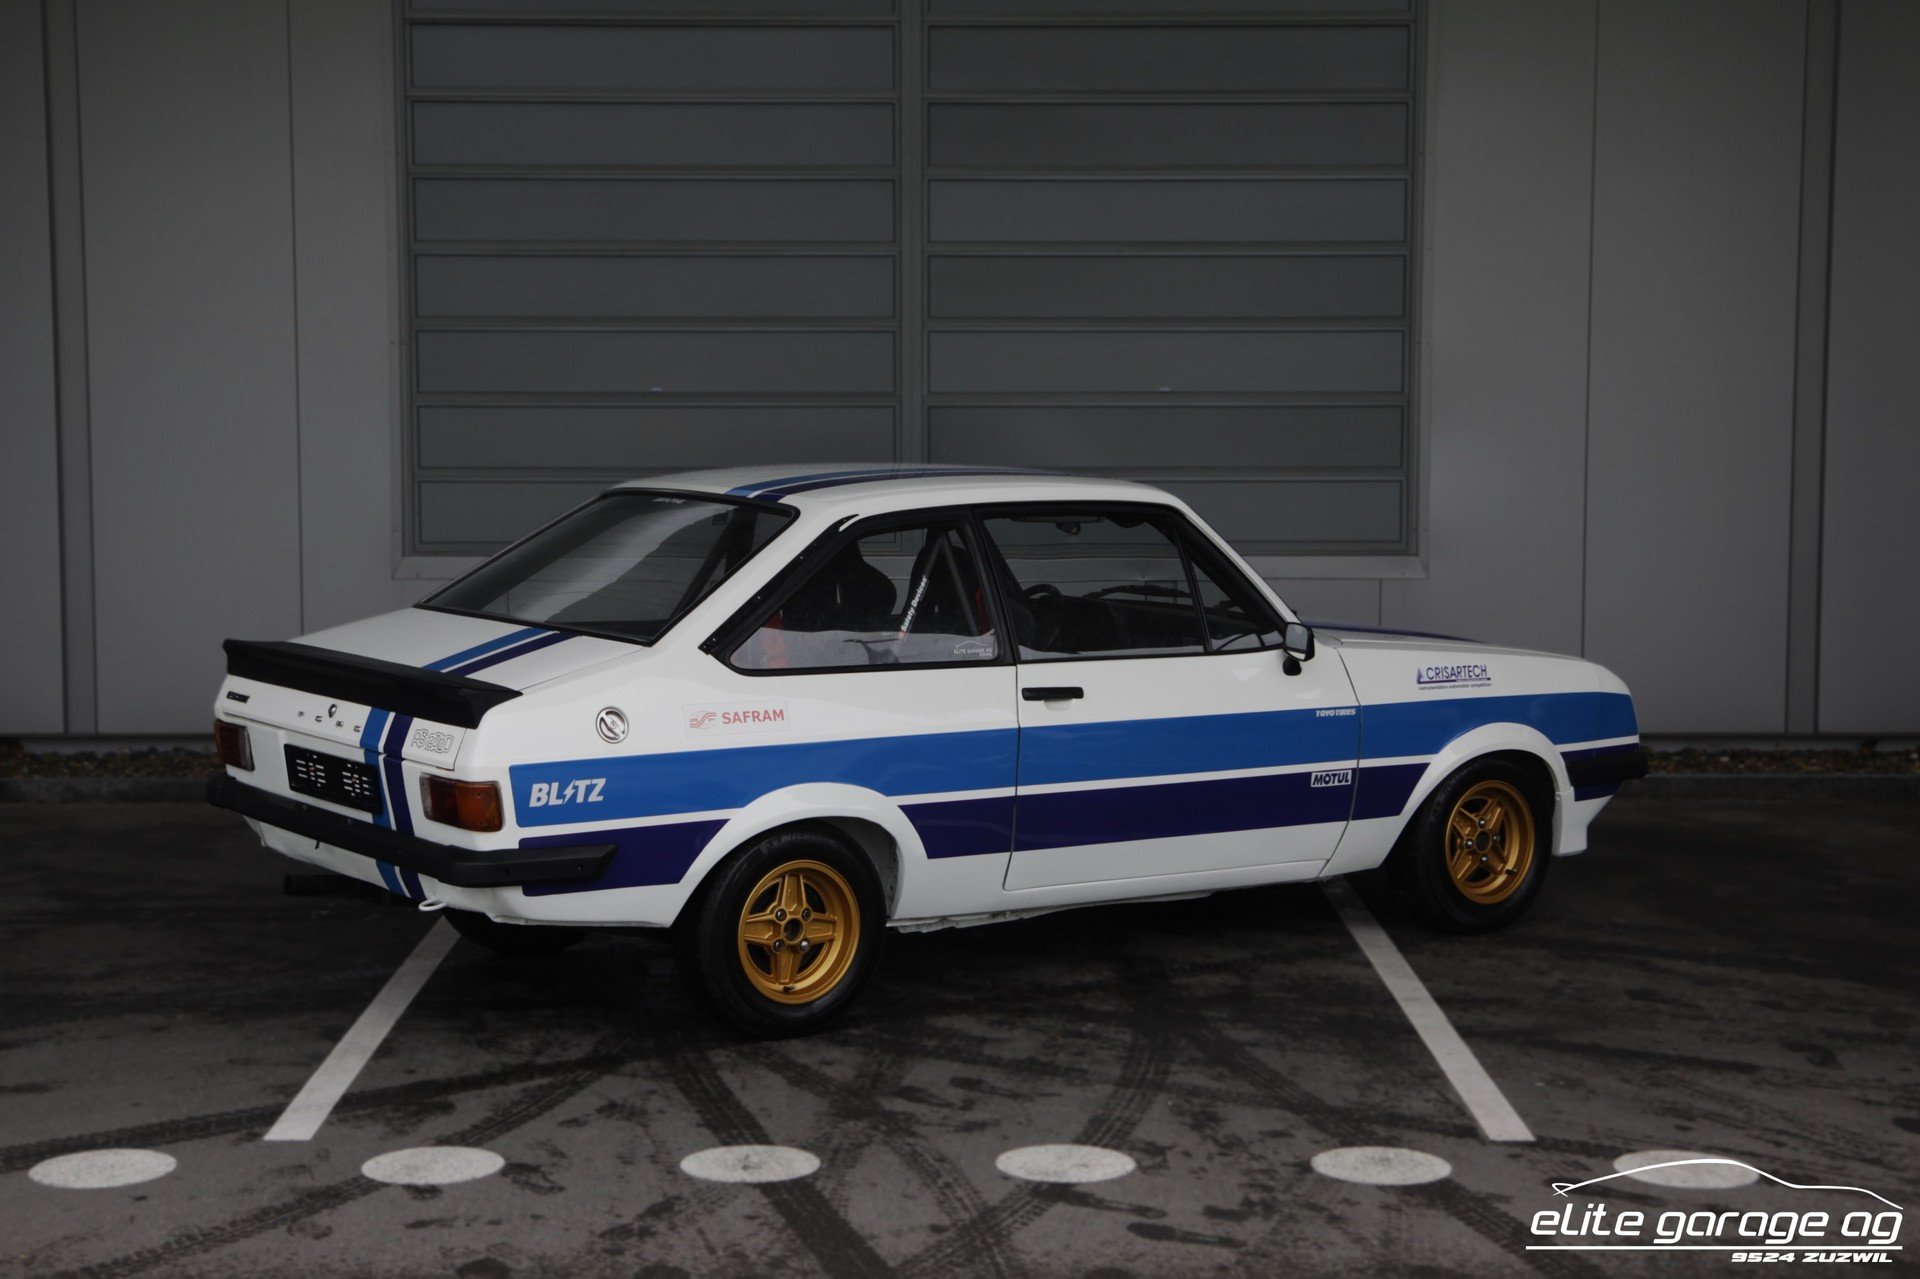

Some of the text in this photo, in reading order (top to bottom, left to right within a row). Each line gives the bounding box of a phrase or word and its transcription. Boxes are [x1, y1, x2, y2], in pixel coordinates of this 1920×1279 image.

[1426, 664, 1488, 680] CRISARTECH
[721, 709, 785, 724] SAFRAM
[1316, 708, 1356, 718] TOYO TIRES
[1312, 771, 1350, 786] MOTUL
[529, 777, 607, 808] BLITZ
